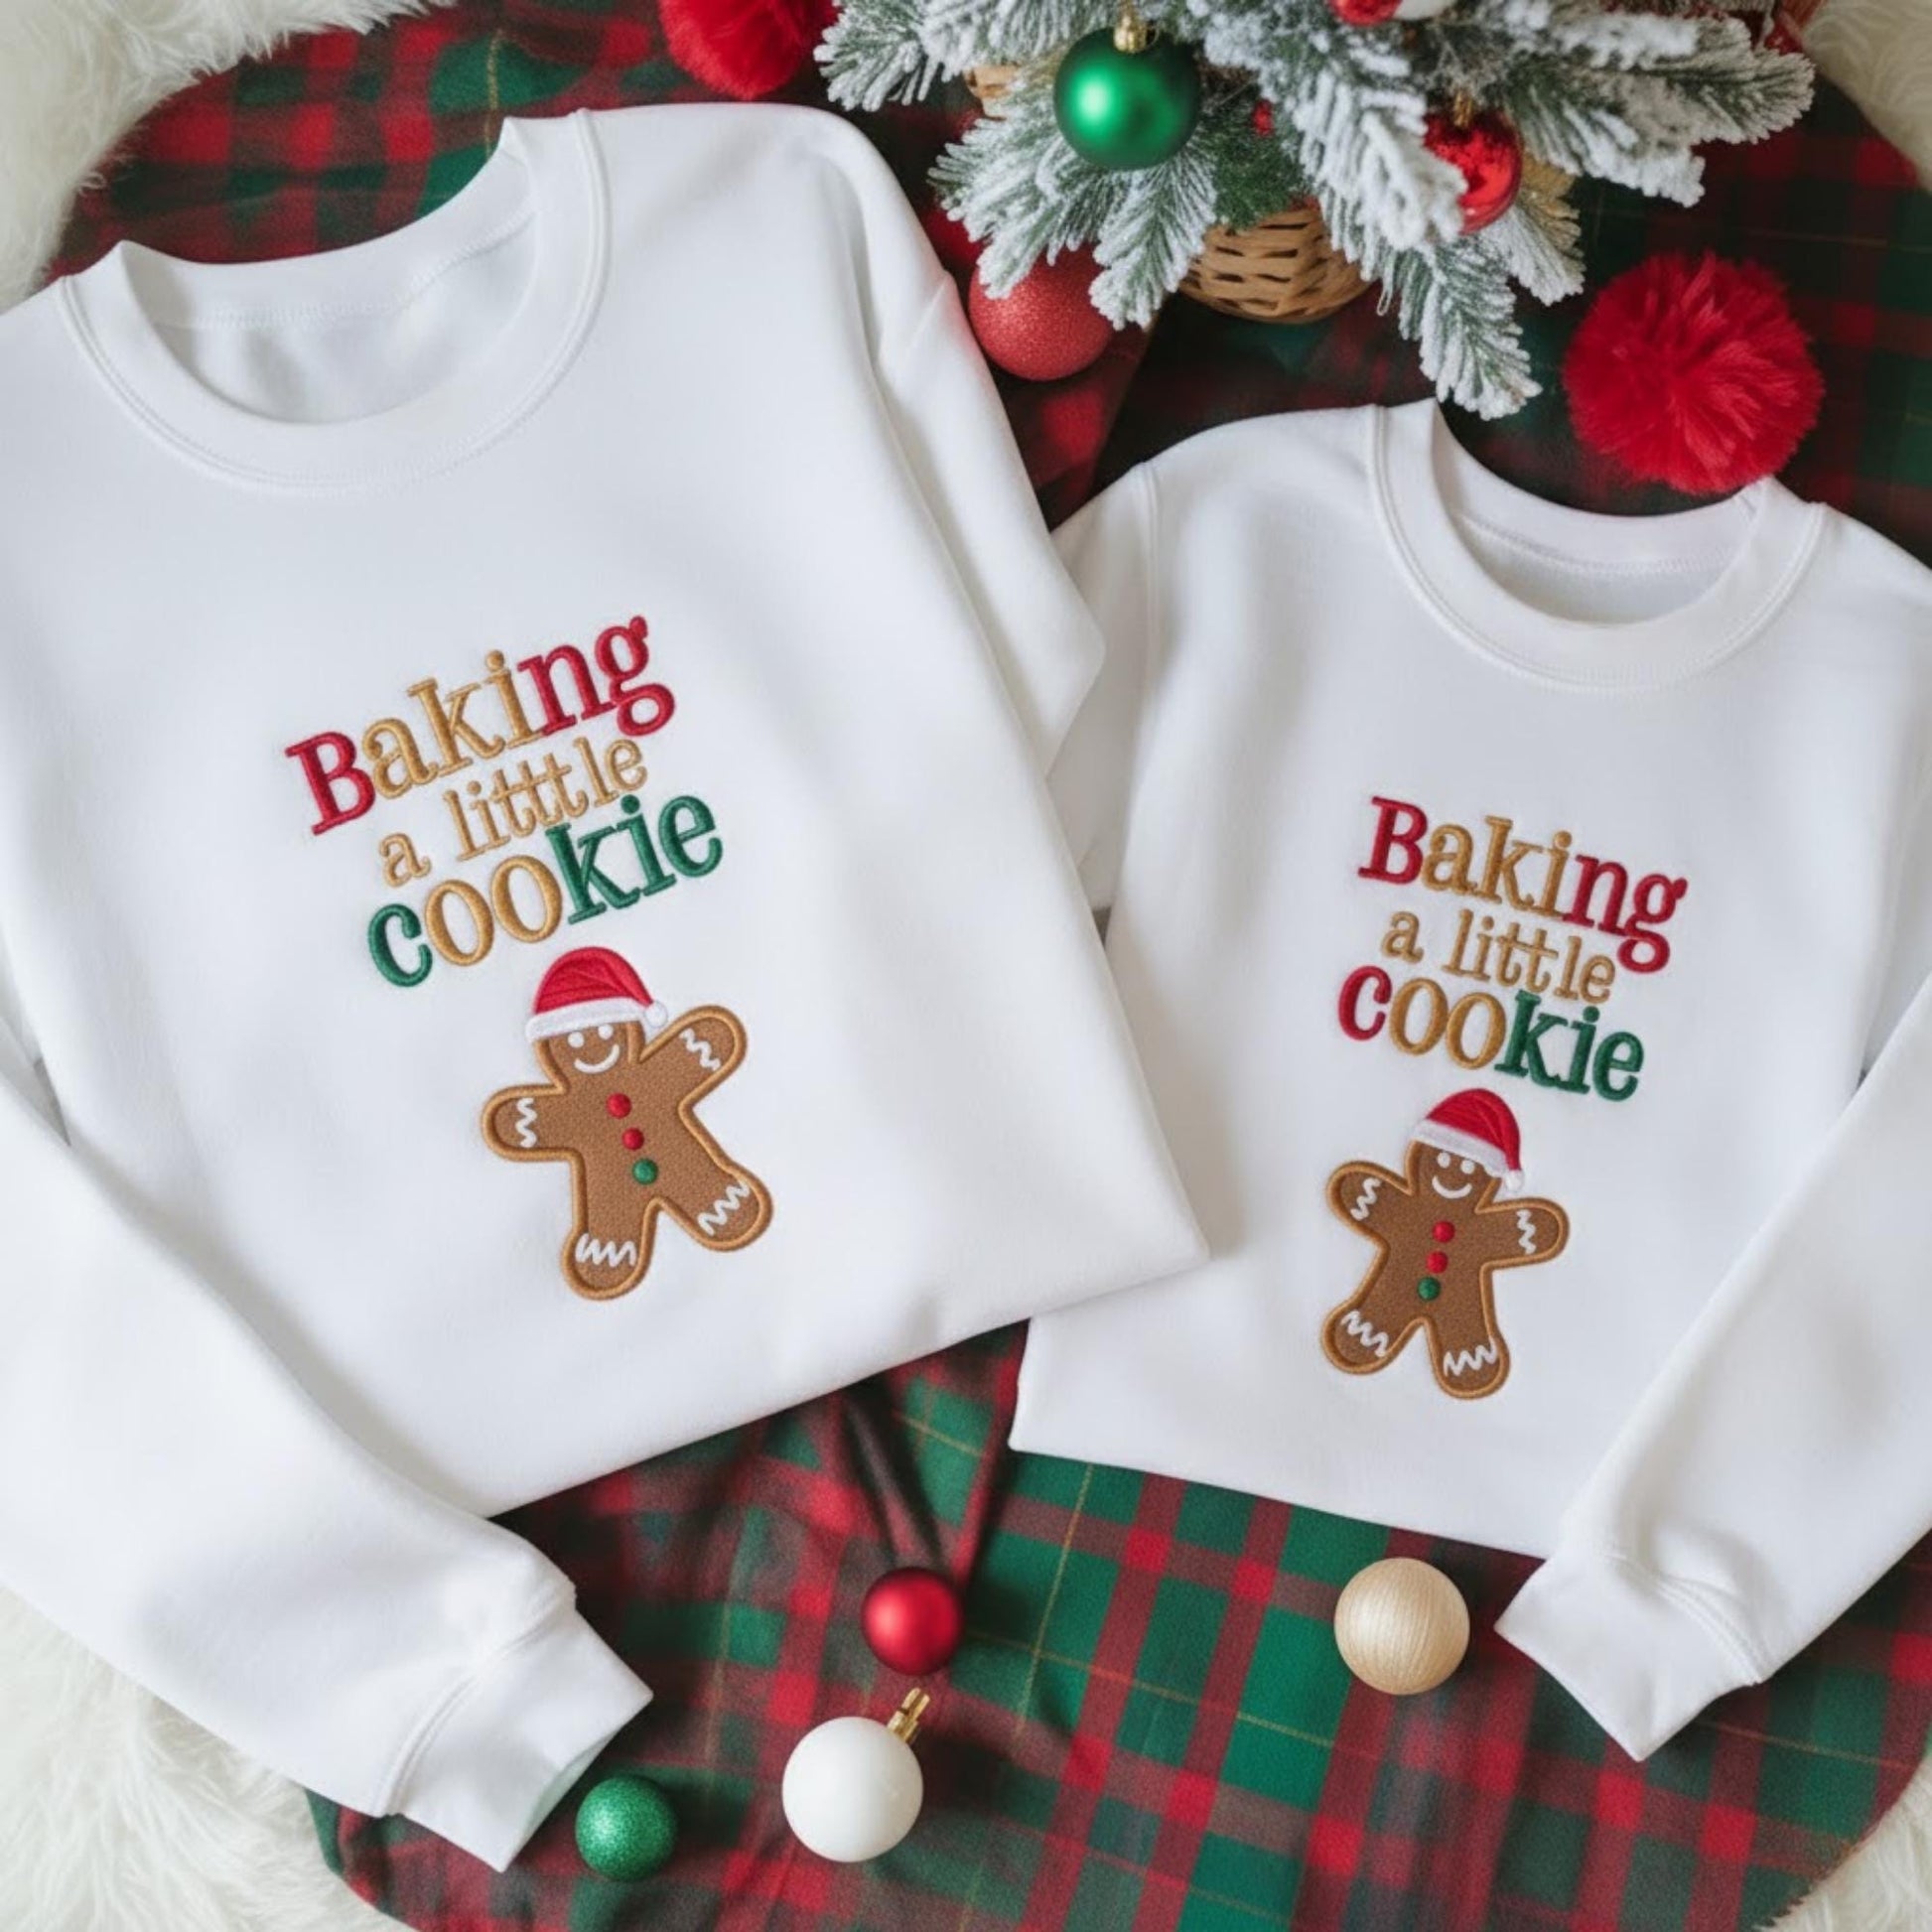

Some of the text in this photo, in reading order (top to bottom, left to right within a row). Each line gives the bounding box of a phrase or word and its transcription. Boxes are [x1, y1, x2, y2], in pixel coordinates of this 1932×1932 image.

[285, 616, 676, 835] Baking
[366, 793, 724, 989] cookie
[377, 831, 432, 888] a
[1358, 795, 1689, 974] Baking
[1337, 965, 1645, 1102] cookie
[1380, 907, 1616, 1005] a little
